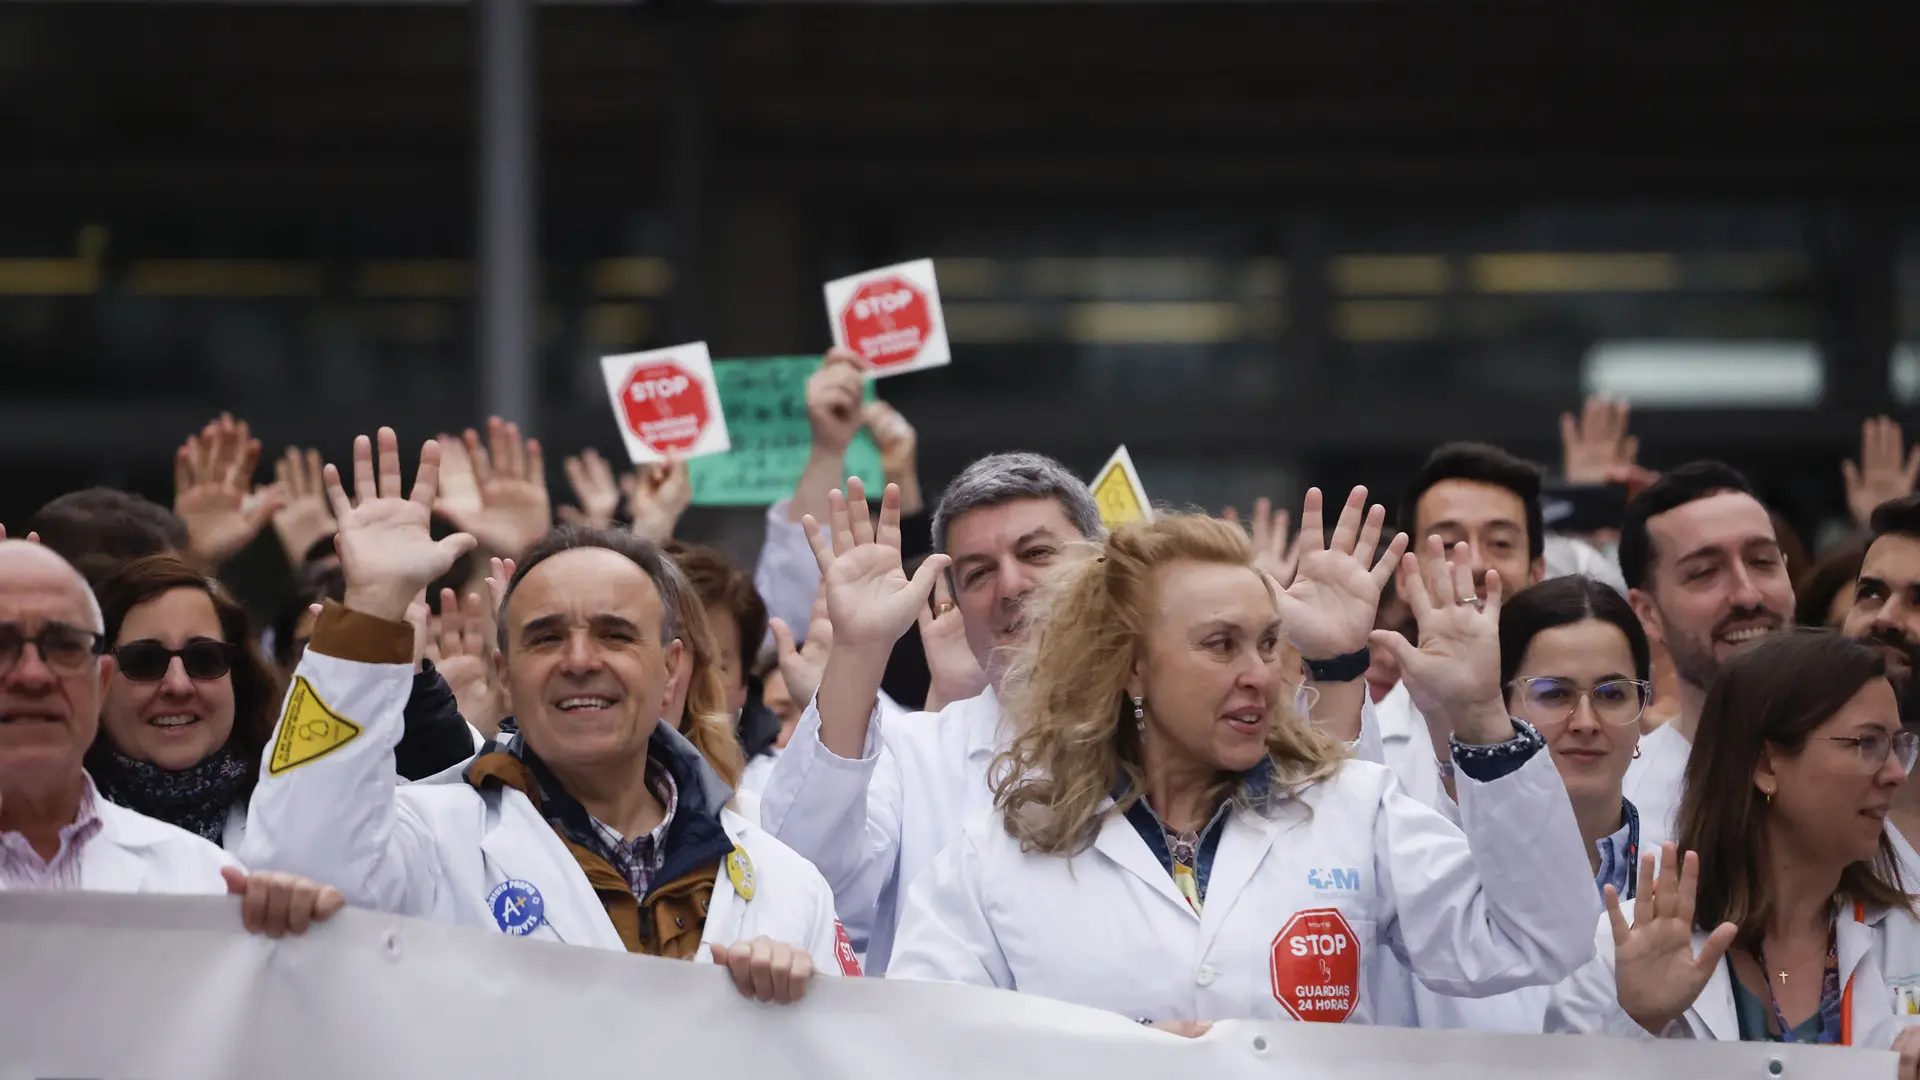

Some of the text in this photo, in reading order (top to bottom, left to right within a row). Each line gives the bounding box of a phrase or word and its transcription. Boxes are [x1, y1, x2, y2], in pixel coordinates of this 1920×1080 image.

[855, 289, 912, 319] STOP
[631, 376, 688, 402] STOP
[1290, 934, 1347, 956] STOP
[1295, 985, 1350, 997] GUARDIAS
[1298, 998, 1349, 1010] 24 HORAS
